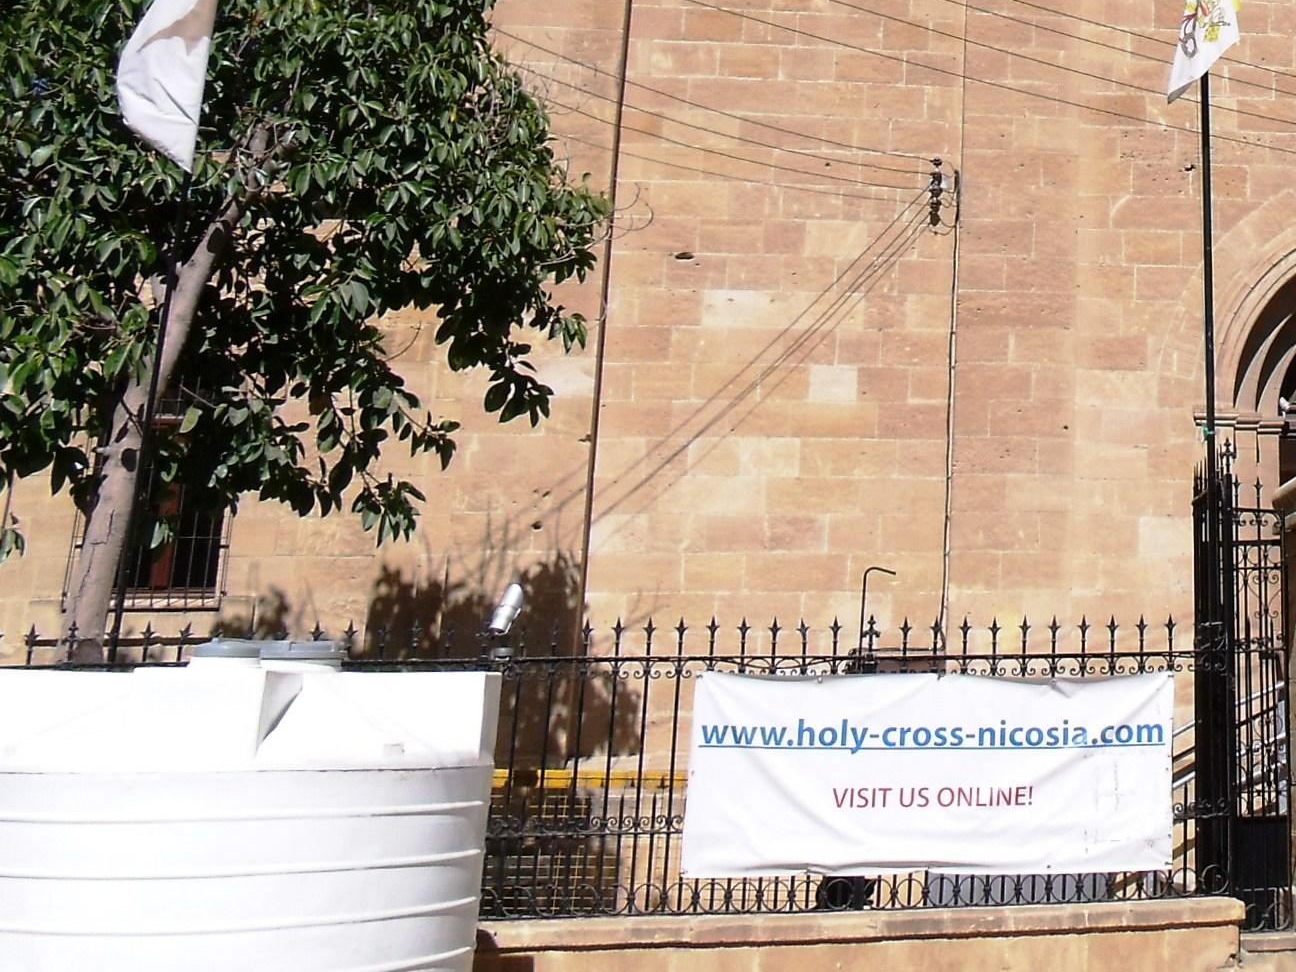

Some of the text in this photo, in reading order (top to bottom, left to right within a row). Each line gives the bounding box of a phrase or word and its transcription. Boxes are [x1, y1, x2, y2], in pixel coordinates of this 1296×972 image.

[702, 719, 1164, 754] www.holy-cross-nicosia.com
[832, 786, 1034, 809] VISIT US ONLINE!
